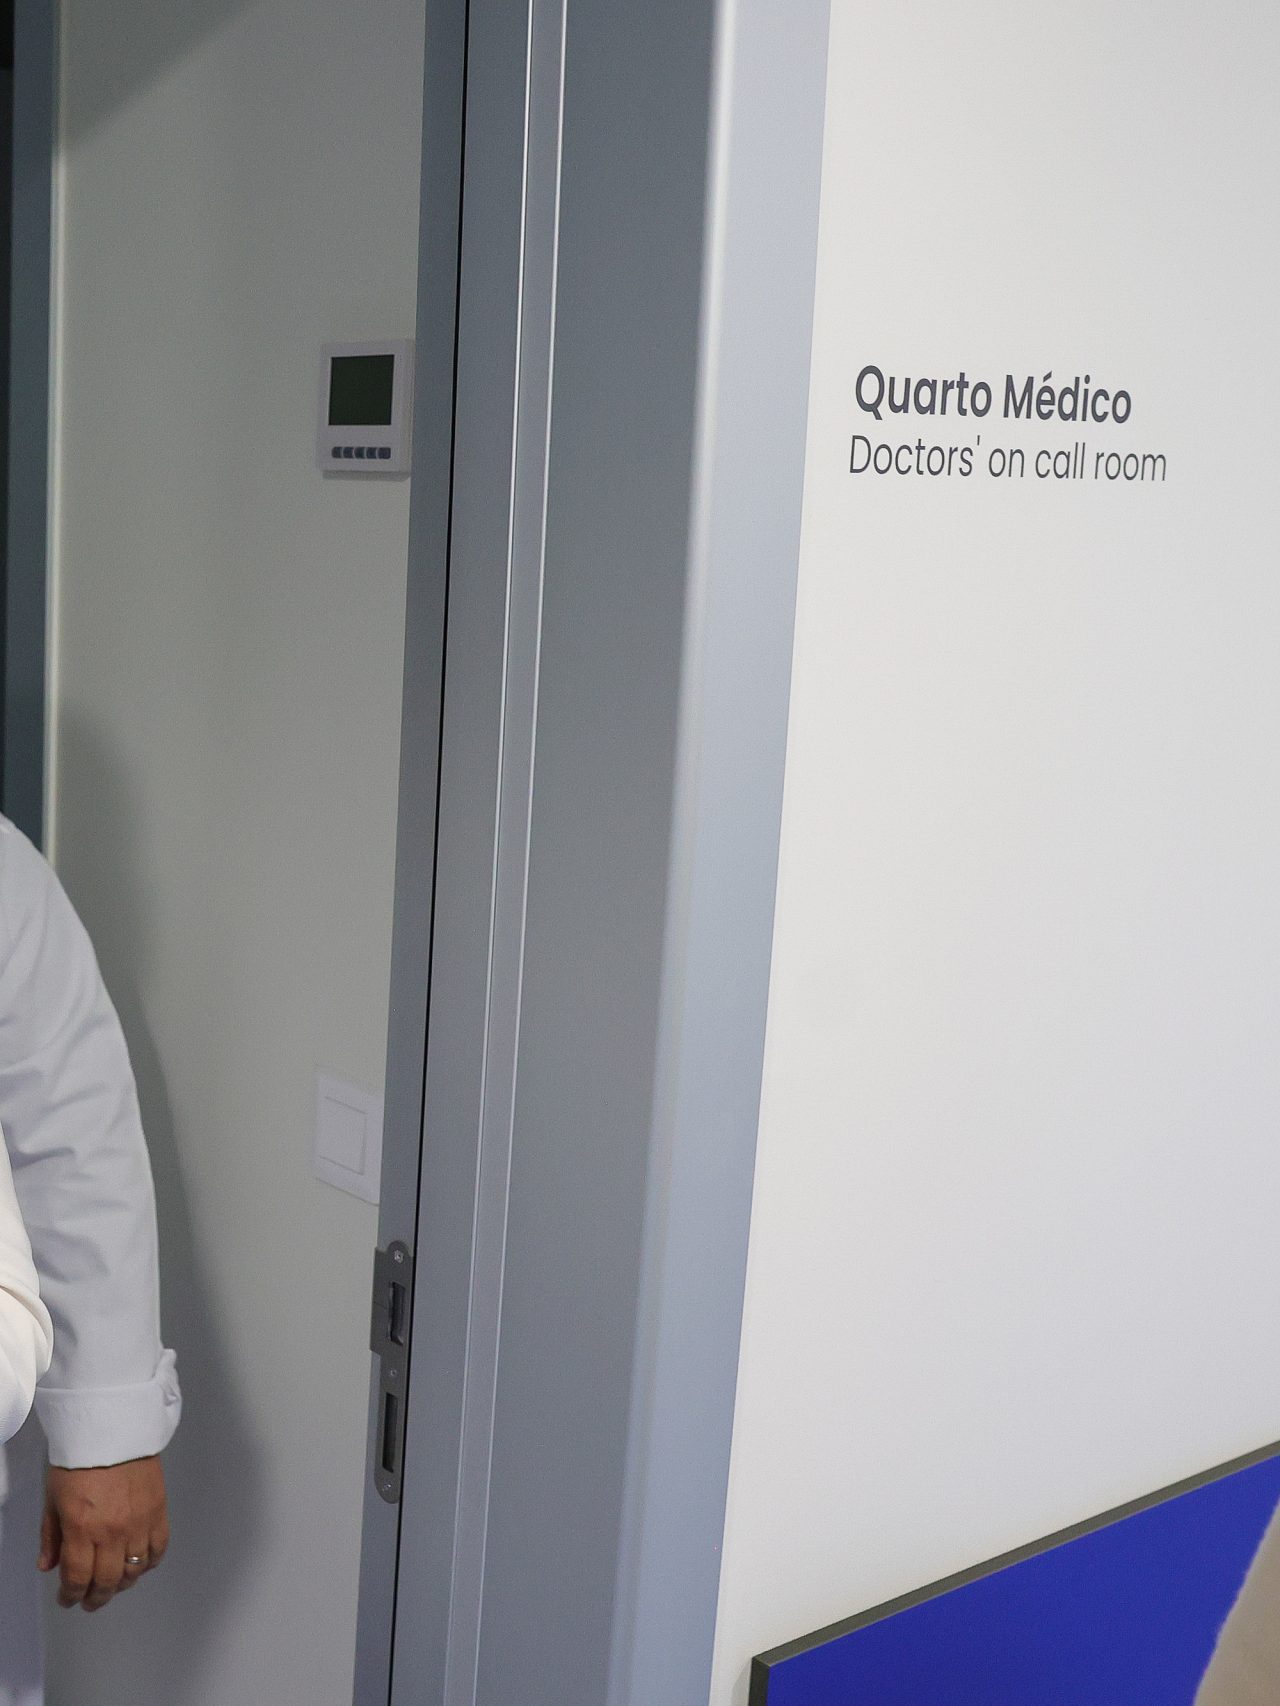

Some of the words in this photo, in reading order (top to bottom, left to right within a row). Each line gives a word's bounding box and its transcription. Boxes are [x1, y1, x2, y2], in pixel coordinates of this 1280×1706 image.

[855, 364, 993, 421] Quarto
[1002, 370, 1132, 424] Médico
[849, 434, 981, 477] Doctors'
[988, 447, 1025, 478] on
[1035, 441, 1086, 480] call
[1094, 452, 1167, 482] room
